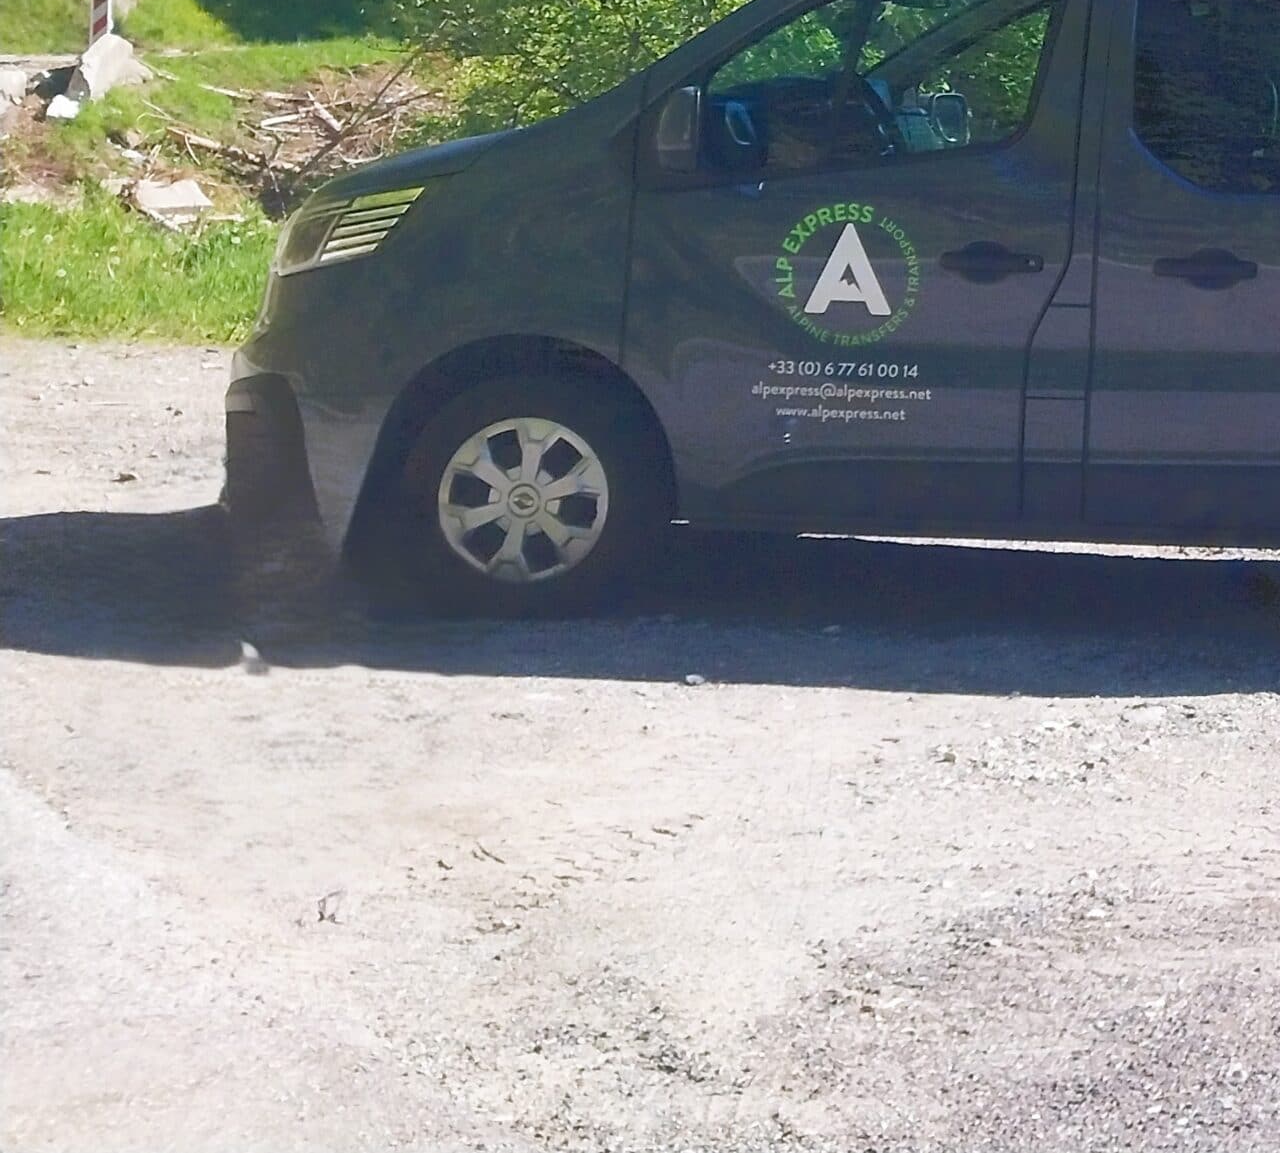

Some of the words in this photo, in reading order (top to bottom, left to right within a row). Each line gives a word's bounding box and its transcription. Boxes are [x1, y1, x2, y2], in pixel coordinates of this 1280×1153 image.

[783, 202, 875, 254] EXPRESS
[775, 256, 797, 298] ALP
[786, 304, 830, 344] ALPINE
[833, 309, 910, 347] TRANSFERS
[879, 216, 920, 292] TRANSPORT
[768, 360, 795, 375] +33
[798, 360, 821, 377] (0)
[824, 362, 834, 376] 6
[837, 362, 856, 376] 77
[858, 363, 873, 377] 61
[877, 363, 899, 378] 00
[902, 364, 919, 379] 14
[751, 381, 932, 403] alpexpress@alpexpress.net
[775, 404, 906, 423] www.alpexpress.net
